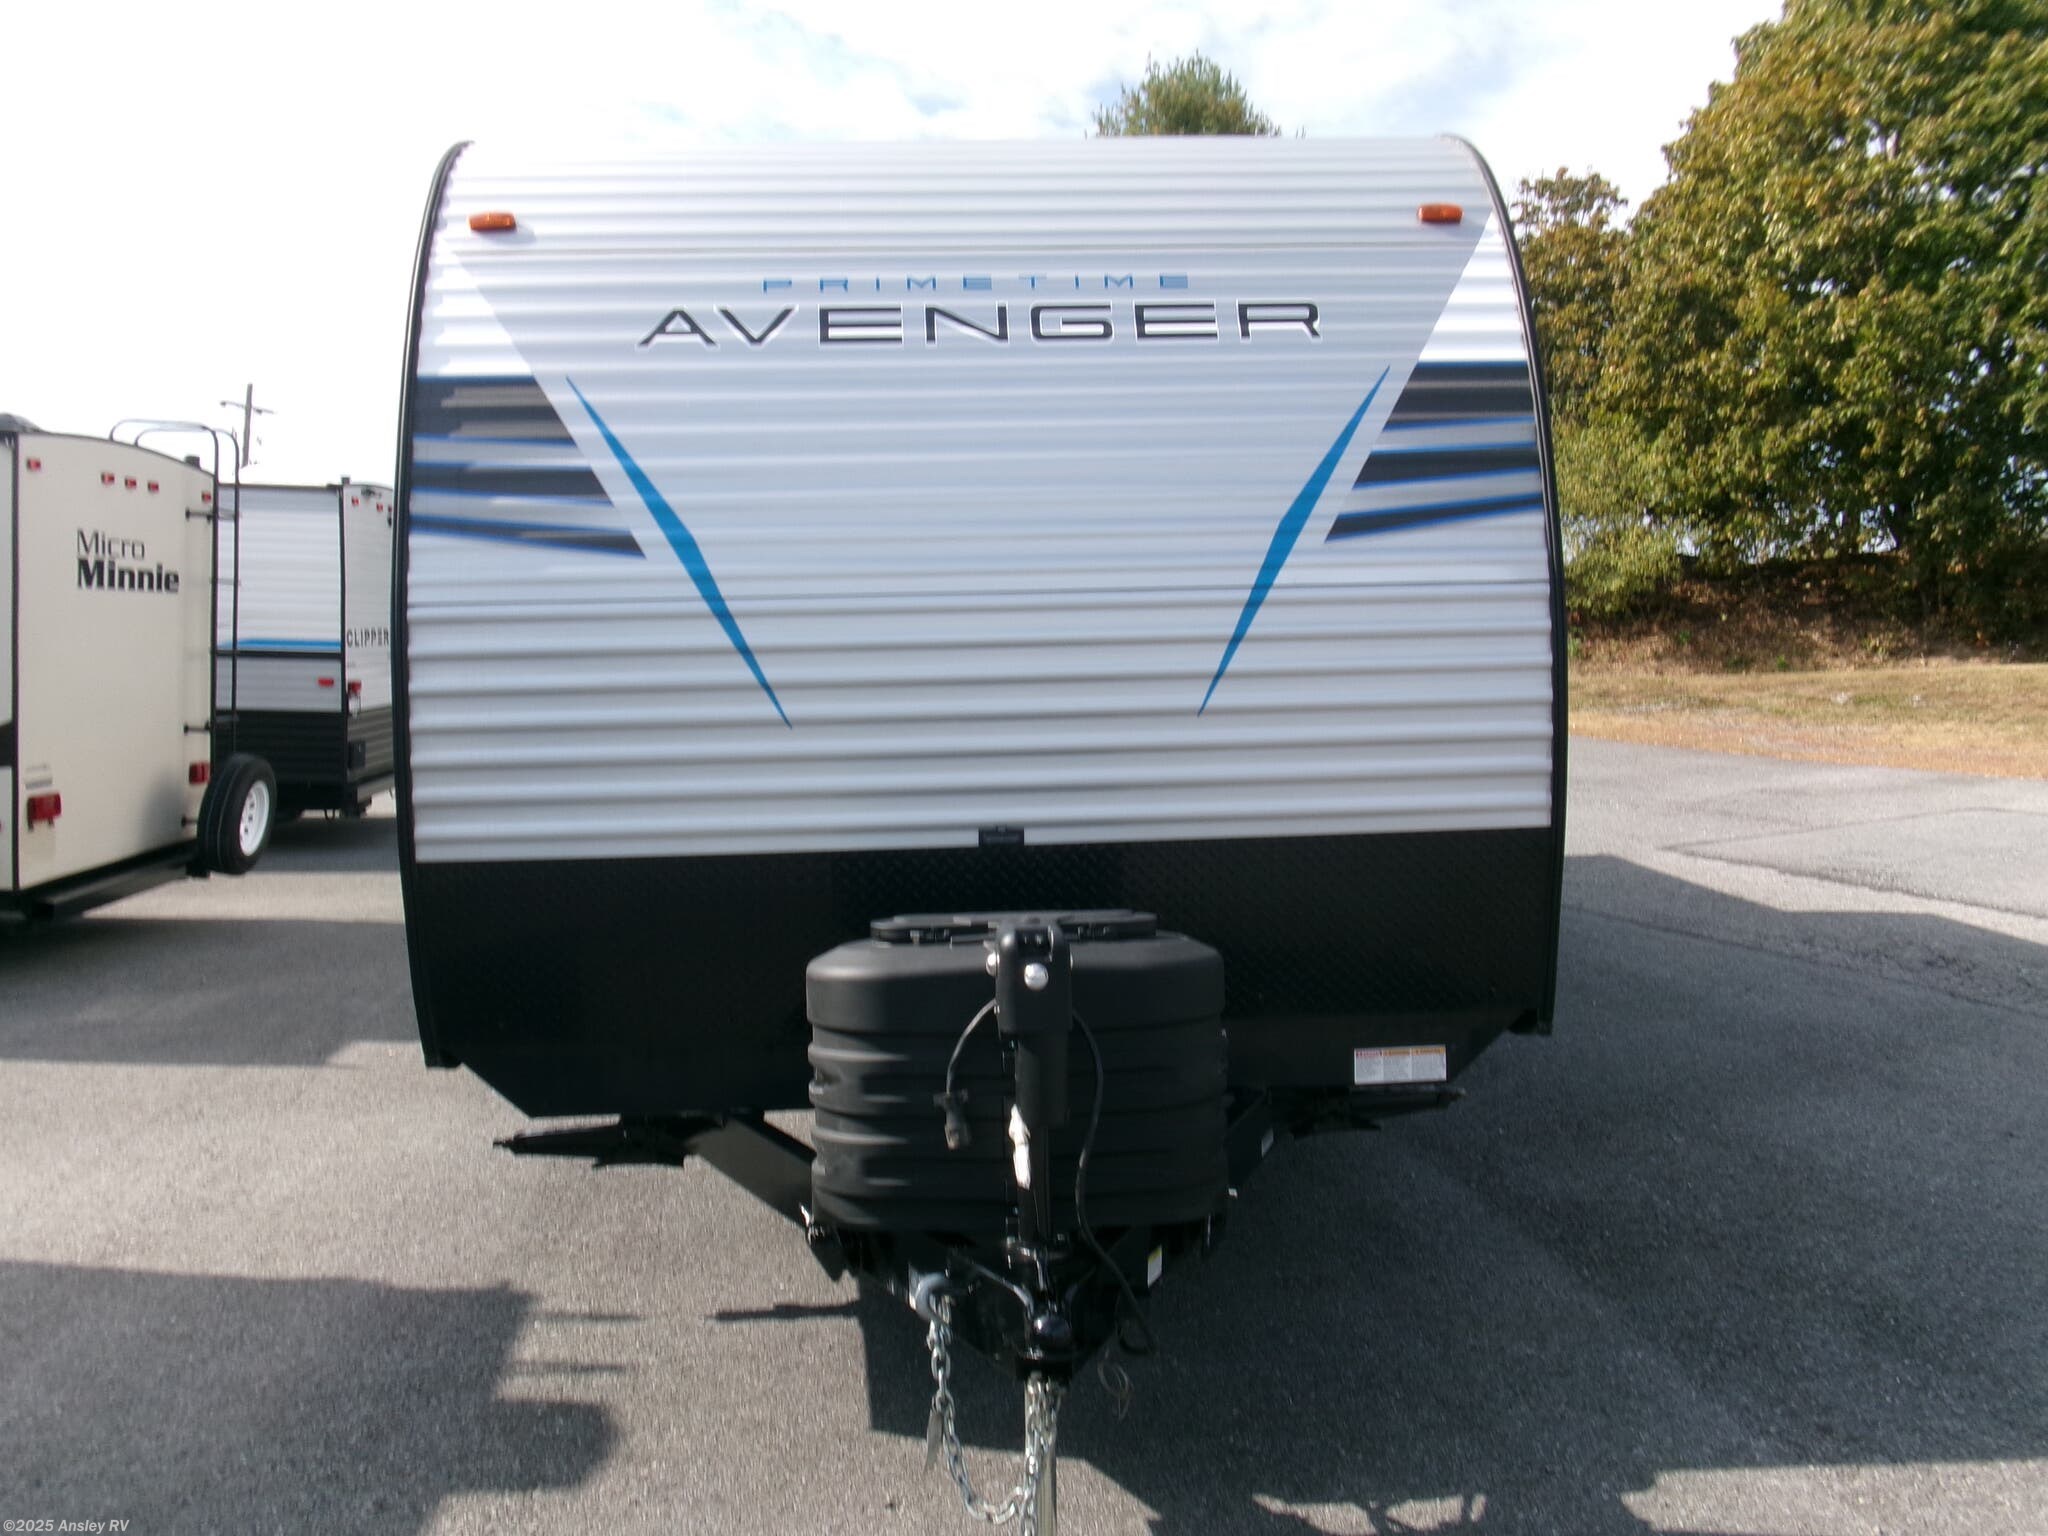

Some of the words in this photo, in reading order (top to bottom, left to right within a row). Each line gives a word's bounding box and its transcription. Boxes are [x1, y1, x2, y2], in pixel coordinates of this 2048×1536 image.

[637, 301, 1322, 347] AVENGER
[77, 528, 145, 560] Micro
[77, 558, 180, 593] Minnie
[346, 627, 390, 648] CLIPPER
